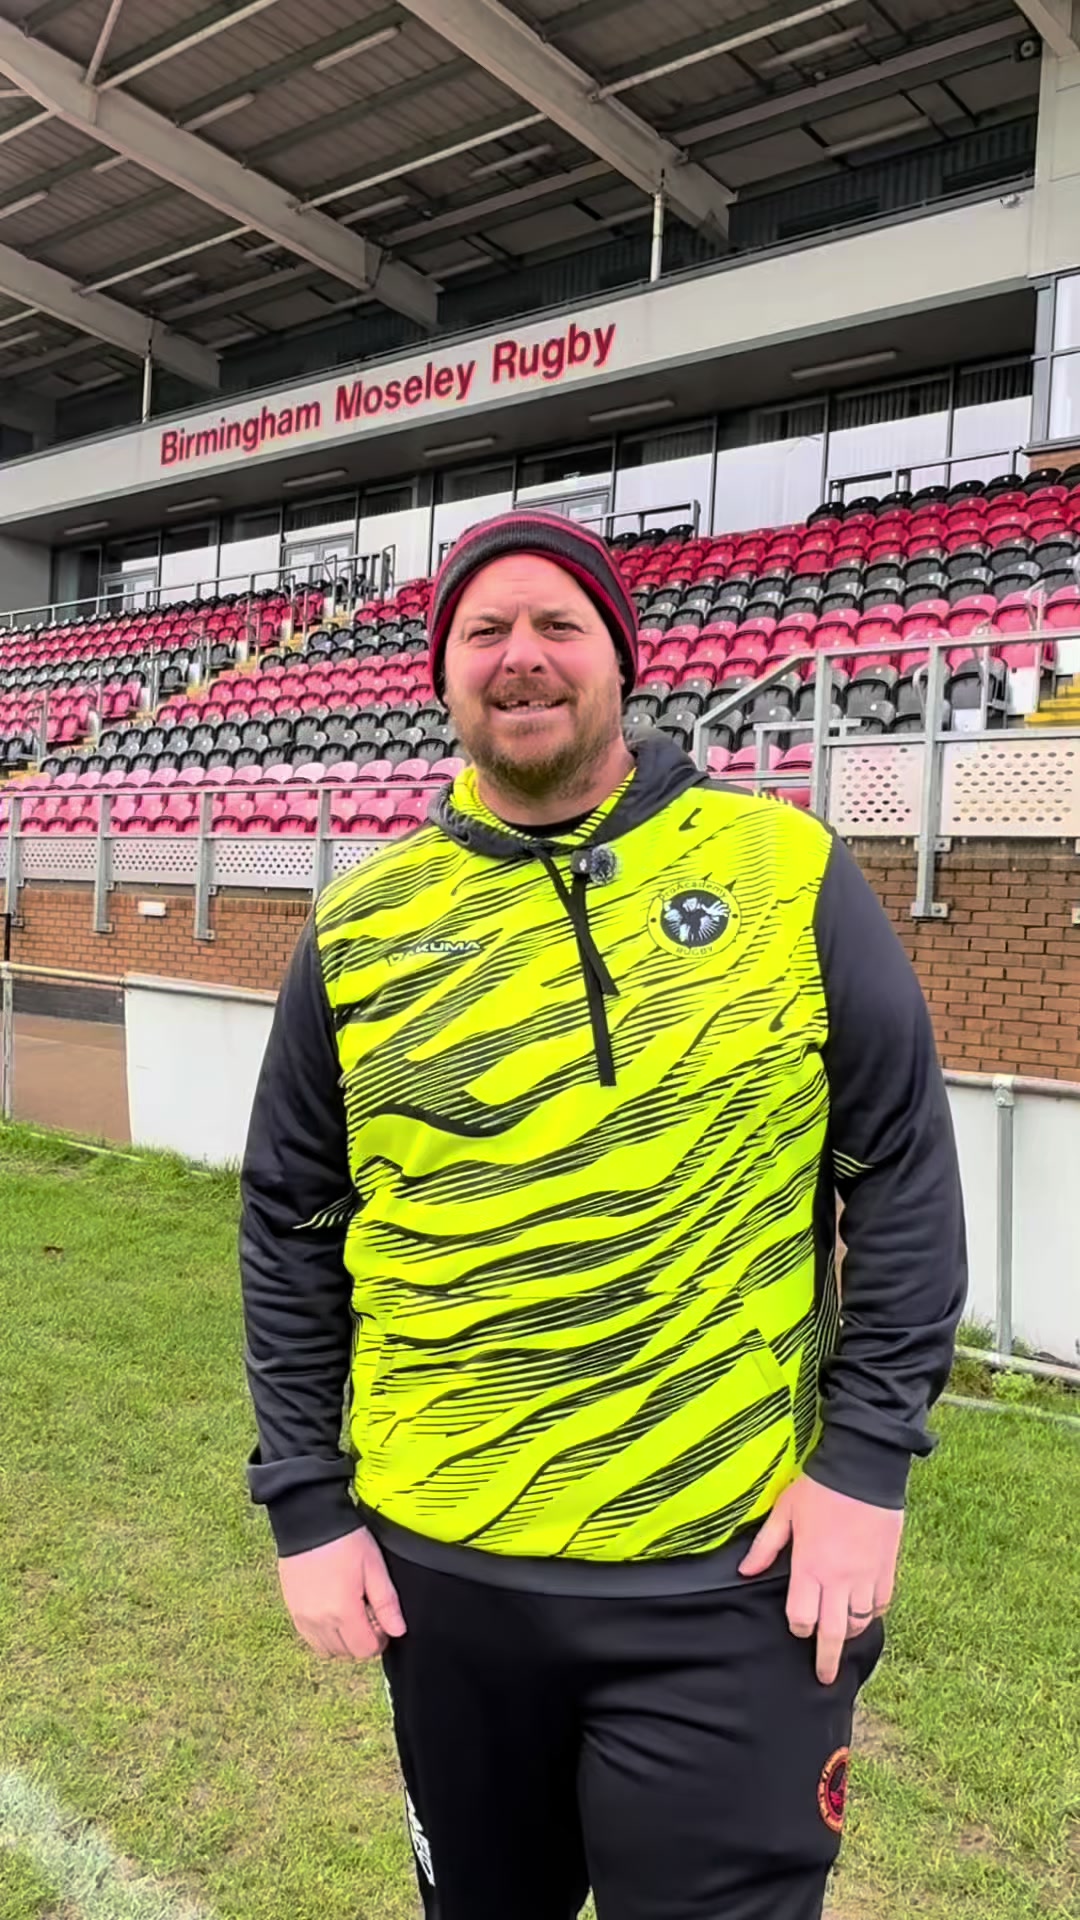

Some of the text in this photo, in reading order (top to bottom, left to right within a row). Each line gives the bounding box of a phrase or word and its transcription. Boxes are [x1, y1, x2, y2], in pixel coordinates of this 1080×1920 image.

[161, 323, 616, 465] Birmingham Moseley Rugby
